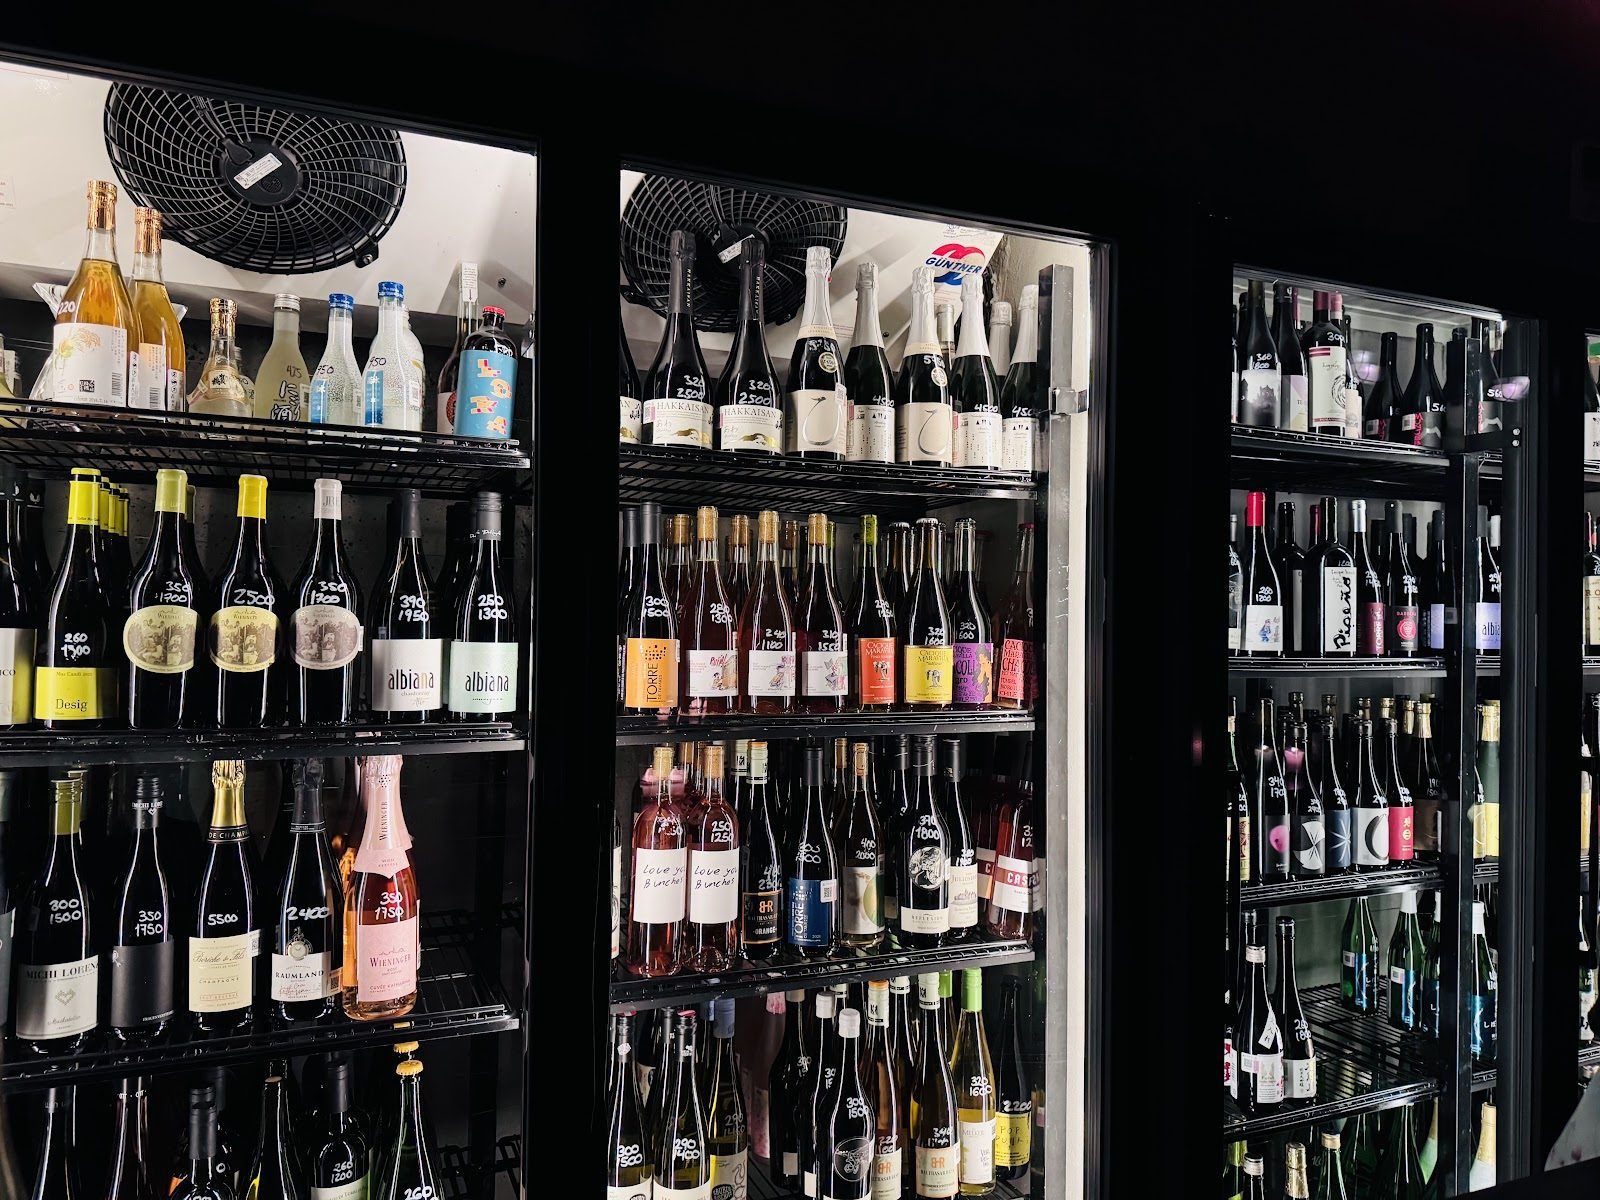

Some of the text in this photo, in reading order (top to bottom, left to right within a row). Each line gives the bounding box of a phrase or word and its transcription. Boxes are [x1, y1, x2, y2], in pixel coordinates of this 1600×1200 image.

[926, 257, 982, 274] GÜNTNER
[749, 379, 772, 391] 320
[676, 387, 704, 400] 2500
[738, 392, 772, 405] 2500
[657, 402, 709, 415] HAKKAISAN
[724, 407, 776, 419] HAKKAISAN
[233, 589, 275, 605] 2500
[478, 608, 508, 620] 1300
[64, 632, 88, 643] 260
[388, 669, 434, 690] albiana
[465, 671, 509, 692] albiana
[646, 662, 659, 703] TORRE
[55, 698, 88, 712] Desig
[915, 827, 940, 840] 1800
[643, 864, 670, 876] Love
[694, 864, 721, 876] Love
[207, 913, 239, 926] 5500
[794, 902, 805, 939] TORRE
[134, 923, 164, 937] 1750
[369, 952, 412, 968] WIENINGER
[26, 970, 57, 980] MICHI
[275, 969, 325, 979] RAUMLAND
